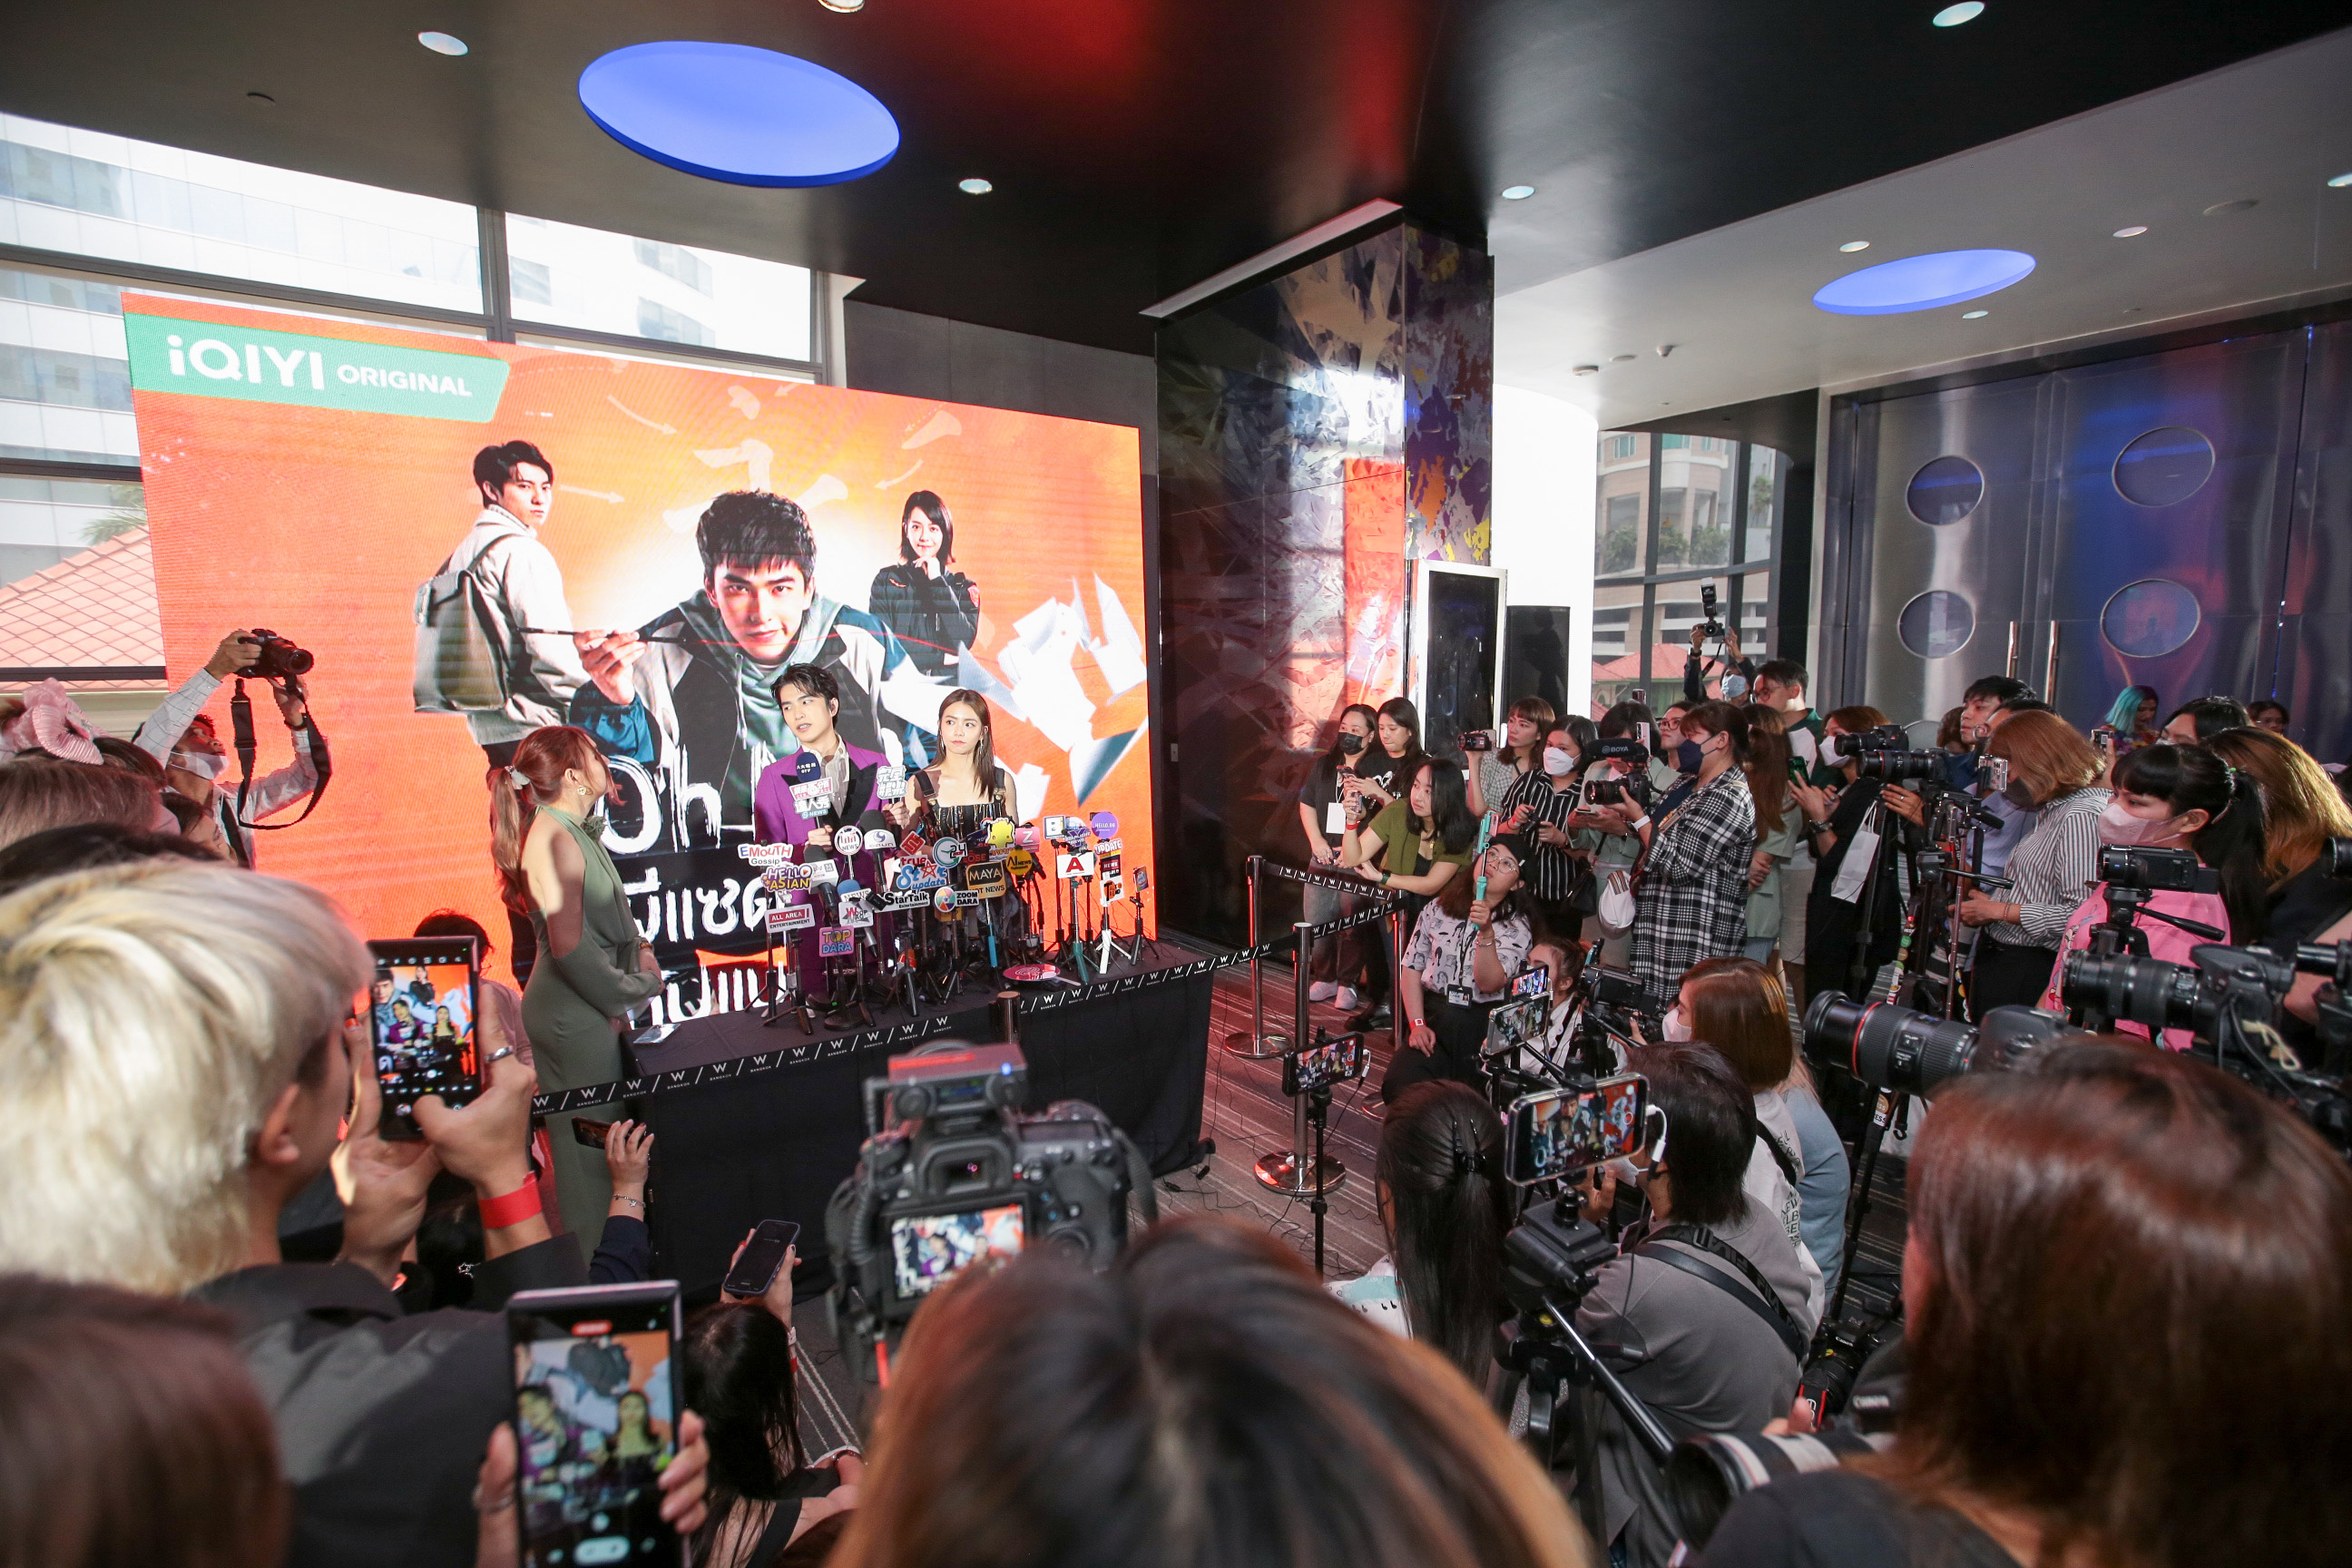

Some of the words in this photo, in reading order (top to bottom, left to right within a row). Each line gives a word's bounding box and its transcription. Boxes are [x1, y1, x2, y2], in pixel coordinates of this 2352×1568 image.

[167, 335, 325, 390] iQIYI
[337, 365, 472, 397] ORIGINAL
[808, 808, 828, 817] NEWS
[1023, 831, 1034, 843] Z
[1094, 839, 1122, 854] UPDATE
[751, 858, 779, 866] Gossip
[901, 857, 926, 866] true
[1066, 857, 1084, 873] A
[768, 865, 812, 879] HELLO
[969, 868, 1002, 881] MAYA
[769, 877, 810, 890] ASIAN
[912, 877, 946, 891] update
[985, 885, 1005, 894] NEWS
[884, 893, 928, 906] StarTalk
[771, 913, 785, 921] ALL
[786, 911, 803, 919] AREA
[769, 919, 810, 928] ENTERTAINMENT
[822, 930, 851, 943] TOP
[822, 943, 852, 954] DARA
[1262, 943, 1270, 952] W
[1241, 949, 1250, 958] W
[1197, 960, 1206, 969] W
[1220, 955, 1229, 964] W
[1173, 965, 1183, 975] W
[1150, 971, 1159, 980] W
[1124, 977, 1134, 985] W
[1098, 983, 1108, 992] W
[1071, 988, 1082, 998] W
[1043, 994, 1054, 1004] W
[936, 1015, 948, 1026] W
[901, 1024, 915, 1034] W
[867, 1031, 879, 1042] W
[830, 1040, 843, 1049] W
[792, 1047, 806, 1057] W
[752, 1054, 767, 1065] W
[712, 1062, 727, 1073] W
[671, 1070, 685, 1082] W
[626, 1079, 642, 1090] W
[581, 1087, 596, 1099] W
[533, 1095, 549, 1107] W
